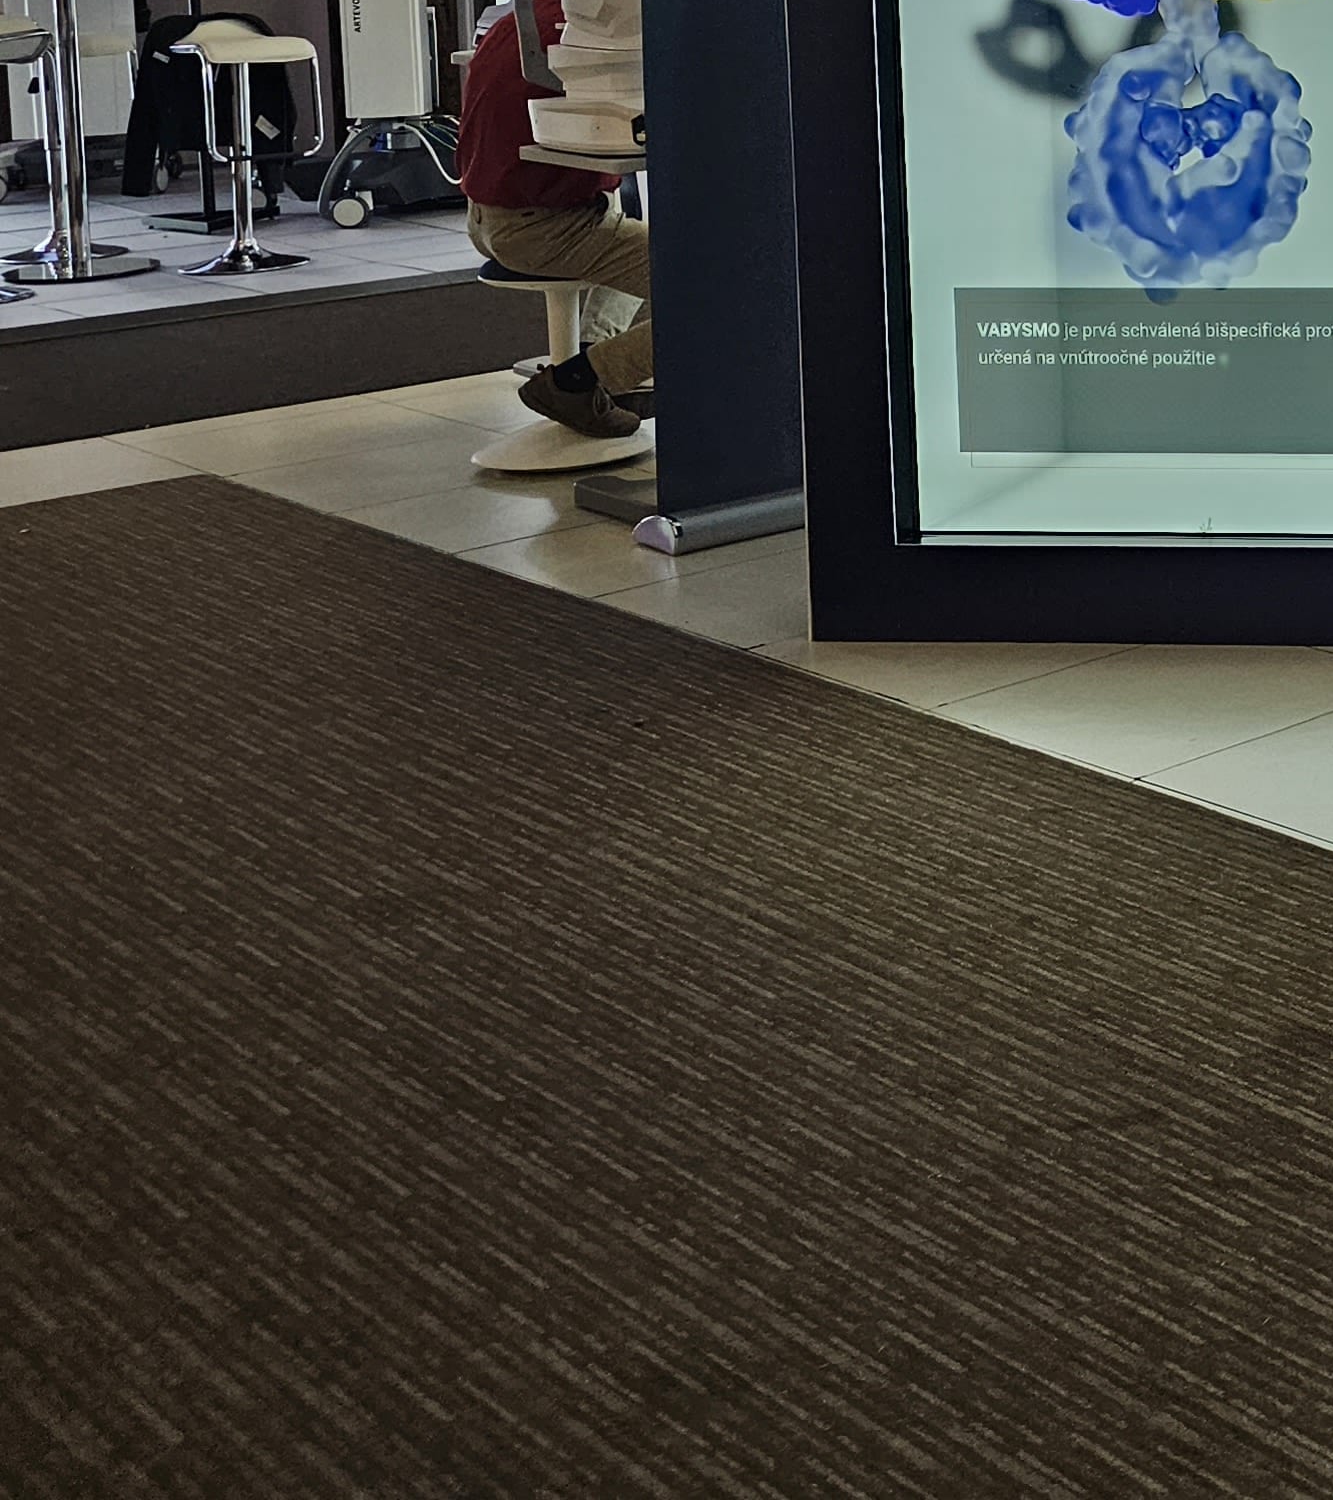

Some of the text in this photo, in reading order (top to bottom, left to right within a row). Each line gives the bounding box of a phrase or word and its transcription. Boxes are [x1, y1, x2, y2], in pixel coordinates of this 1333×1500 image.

[976, 322, 1060, 339] VABYSMO
[1063, 322, 1079, 341] je
[1082, 322, 1117, 343] prvá
[1121, 321, 1201, 339] schválená
[1205, 321, 1301, 343] bišpecifická
[978, 348, 1032, 366] určená
[1036, 352, 1056, 365] na
[1060, 348, 1148, 366] vnútroočné
